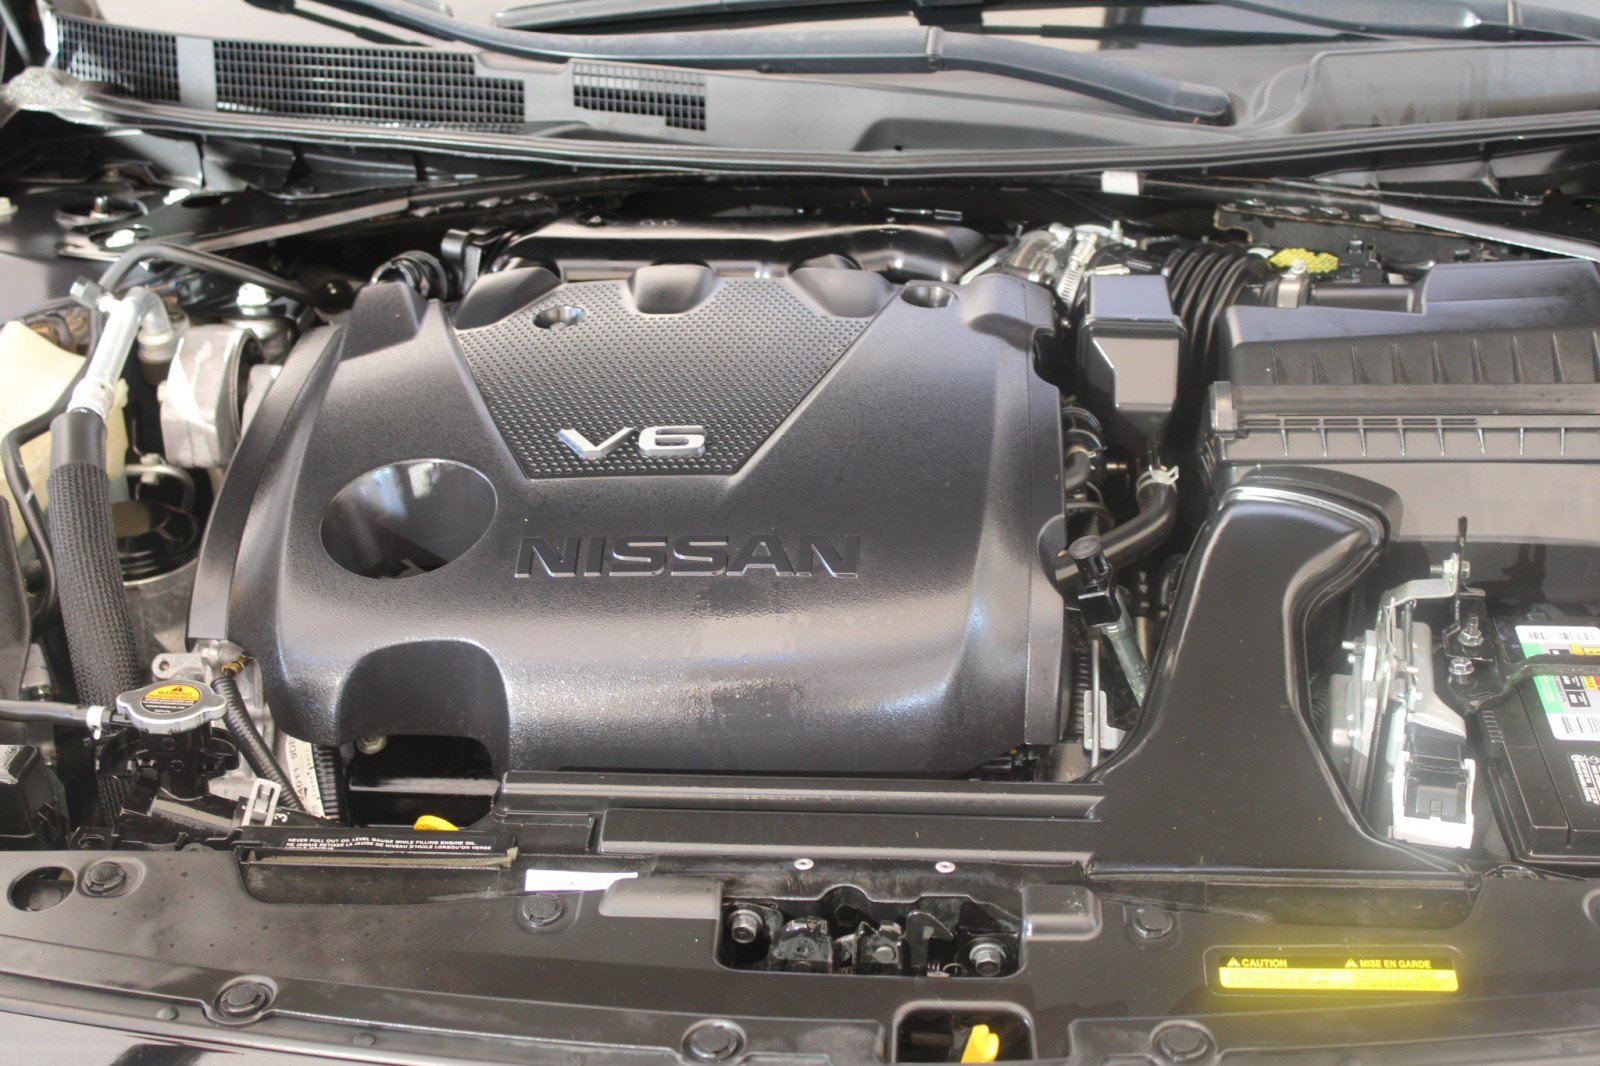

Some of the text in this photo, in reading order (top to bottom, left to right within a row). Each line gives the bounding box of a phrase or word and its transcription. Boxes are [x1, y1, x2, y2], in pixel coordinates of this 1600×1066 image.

[556, 425, 706, 458] V6
[514, 535, 860, 578] NISSAN
[1241, 958, 1431, 969] CAUTION MISE EN GARDE
